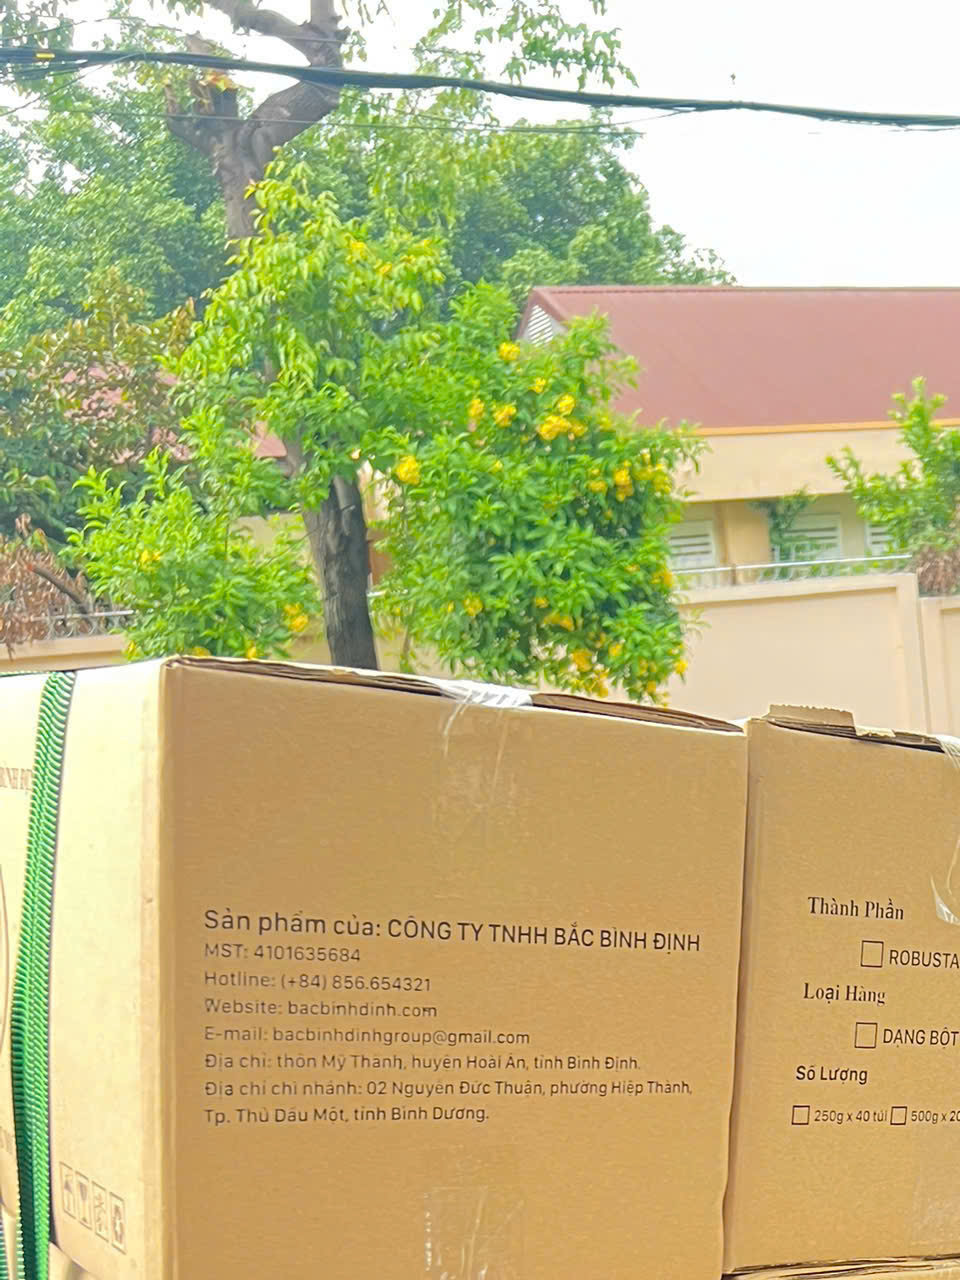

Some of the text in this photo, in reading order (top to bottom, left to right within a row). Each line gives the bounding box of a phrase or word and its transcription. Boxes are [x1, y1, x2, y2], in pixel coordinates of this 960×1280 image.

[808, 896, 905, 920] Thành Phần
[204, 907, 700, 954] Sản phẩm của: CÔNG TY TNHH BẮC BÌNH ĐỊNH
[204, 943, 361, 963] MST: 4101635684
[889, 949, 960, 969] ROBUSTA
[204, 971, 431, 992] Hotline: (+84) 856.654321
[803, 982, 886, 1006] Loại Hàng
[204, 998, 438, 1018] Website: bacbinhdinh.com
[204, 1026, 530, 1046] E-mail: bacbinhdinhgroup@gmail.com
[883, 1028, 926, 1048] DẠNG
[930, 1027, 960, 1049] BỘT
[205, 1053, 234, 1071] Địa
[277, 1053, 317, 1069] thôn
[795, 1064, 868, 1085] Số Lượng
[205, 1081, 234, 1099] Địa
[367, 1081, 388, 1095] 02
[459, 1080, 490, 1095] Đức
[204, 1109, 230, 1126] Tp.
[235, 1107, 270, 1123] Thủ
[432, 1106, 490, 1123] Dương.
[813, 1110, 844, 1125] 250g
[846, 1112, 853, 1122] x
[855, 1110, 870, 1122] 40
[873, 1109, 888, 1122] túi
[911, 1110, 939, 1125] 500g
[941, 1113, 947, 1122] x
